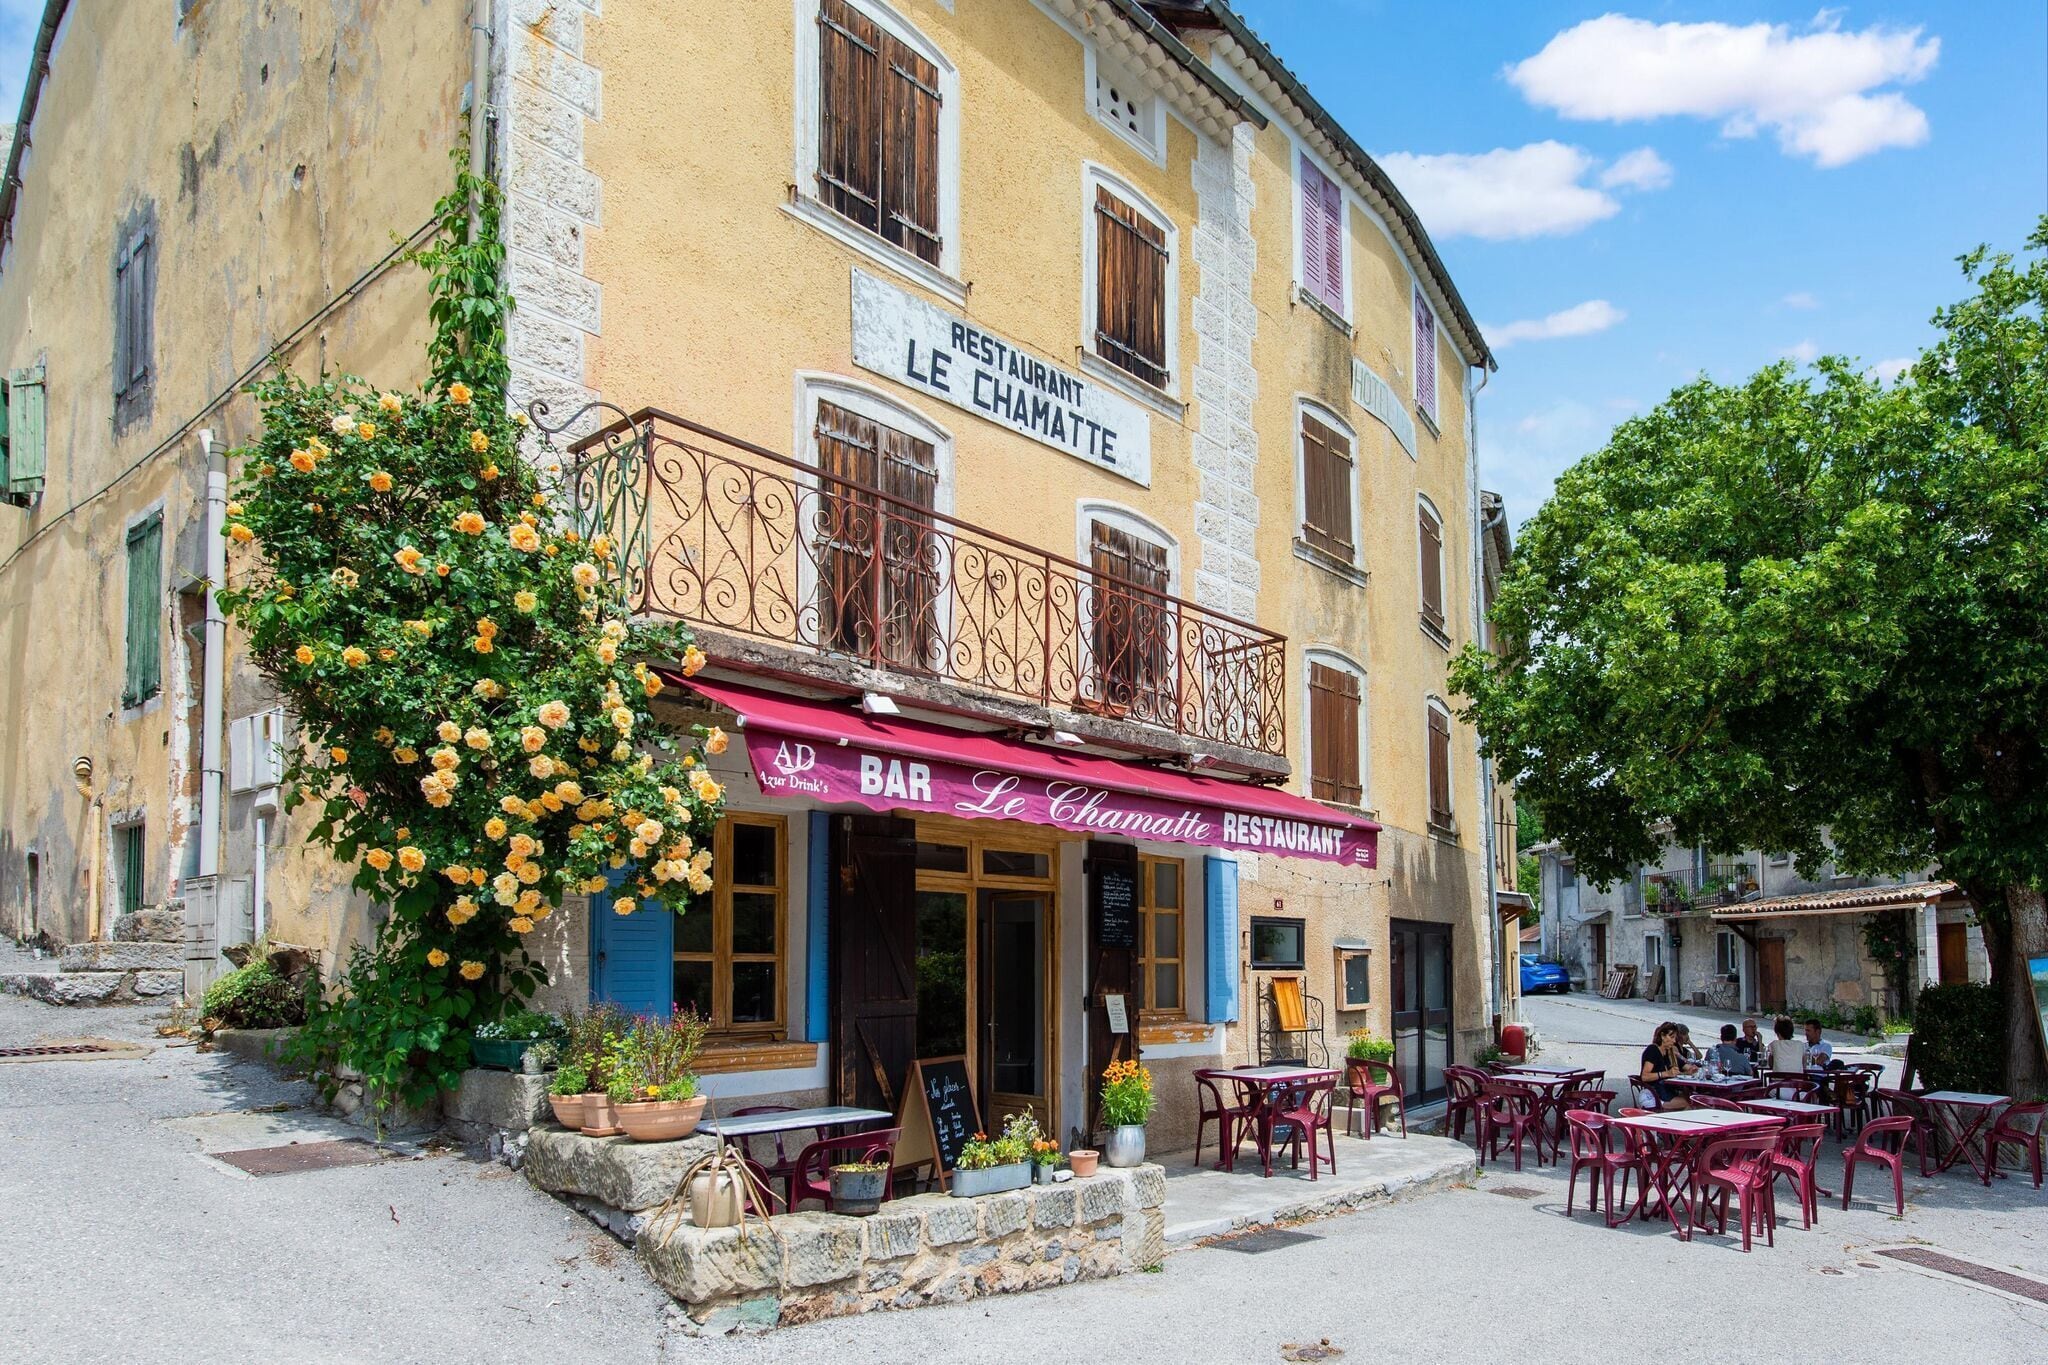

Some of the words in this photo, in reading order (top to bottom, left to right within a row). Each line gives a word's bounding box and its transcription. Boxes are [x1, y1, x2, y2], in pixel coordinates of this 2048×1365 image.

[951, 321, 1084, 407] RESTAURANT
[1353, 363, 1392, 425] HOTEL
[907, 338, 951, 392] LE
[972, 368, 1117, 465] CHAMATTE
[760, 771, 787, 787] Azur
[788, 774, 829, 794] Drink's
[773, 740, 816, 772] AD
[860, 754, 932, 802] BAR
[954, 770, 1026, 816] Le
[1046, 781, 1211, 840] Chamatte
[1223, 811, 1345, 856] RESTAURANT
